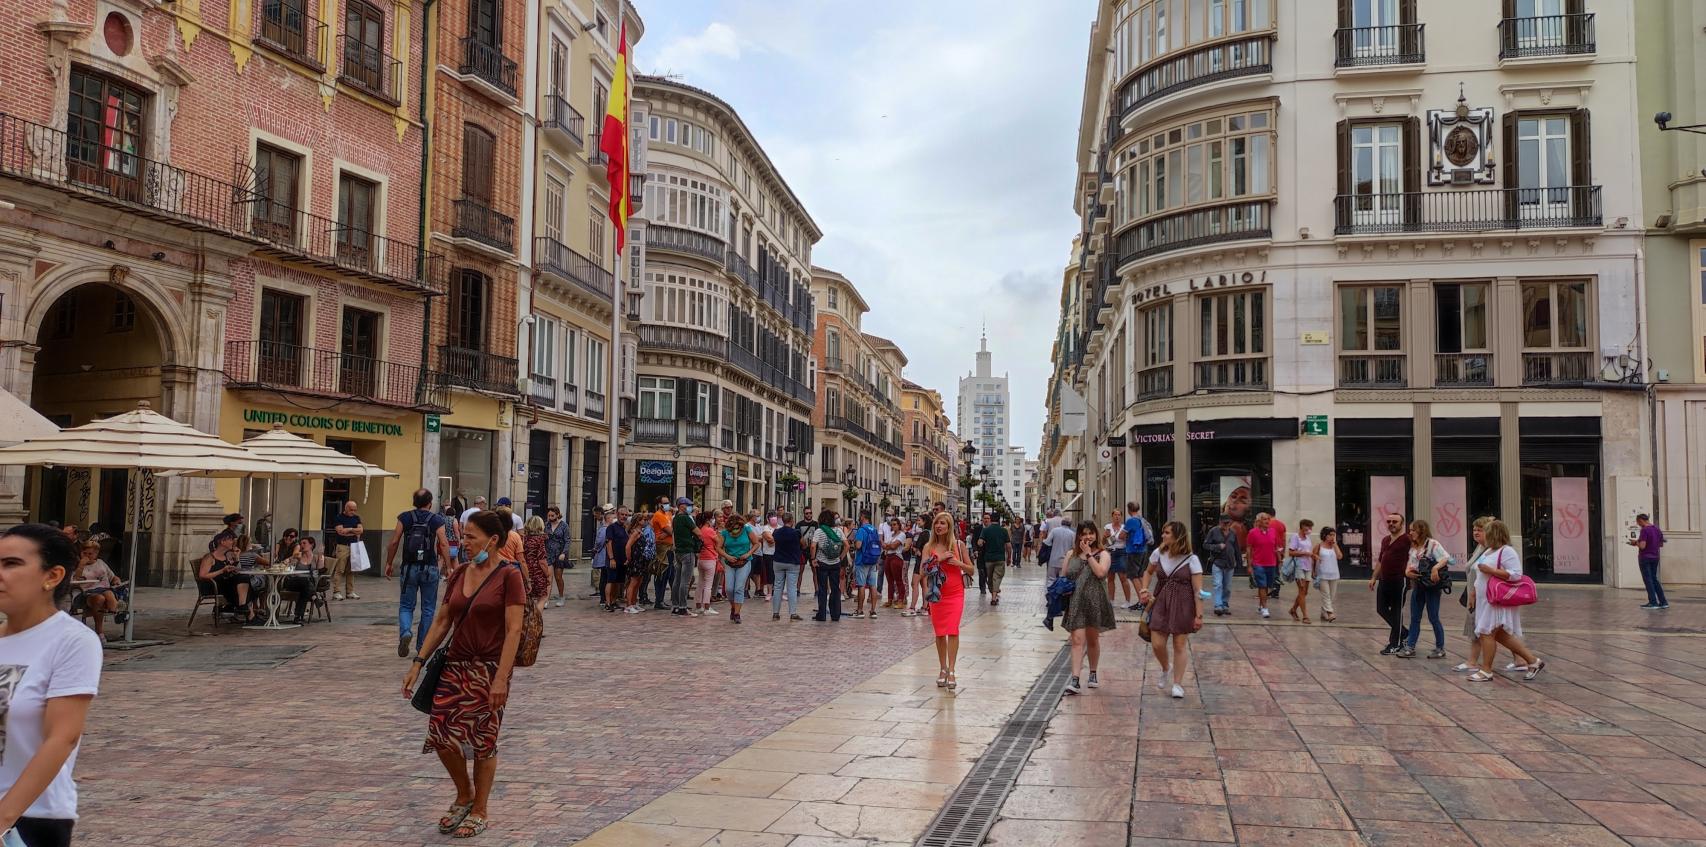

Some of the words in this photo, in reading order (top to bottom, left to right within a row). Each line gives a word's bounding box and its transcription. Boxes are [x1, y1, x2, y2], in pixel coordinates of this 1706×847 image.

[1131, 284, 1172, 305] HOTEL
[1189, 270, 1267, 290] LARIOS
[243, 409, 287, 424] UNITED
[290, 414, 334, 429] COLORS
[335, 419, 350, 431] OF
[1135, 433, 1175, 443] VICTORIA'S
[1186, 431, 1215, 440] SECRET
[640, 467, 673, 476] Desigual
[689, 469, 709, 477] Desigual
